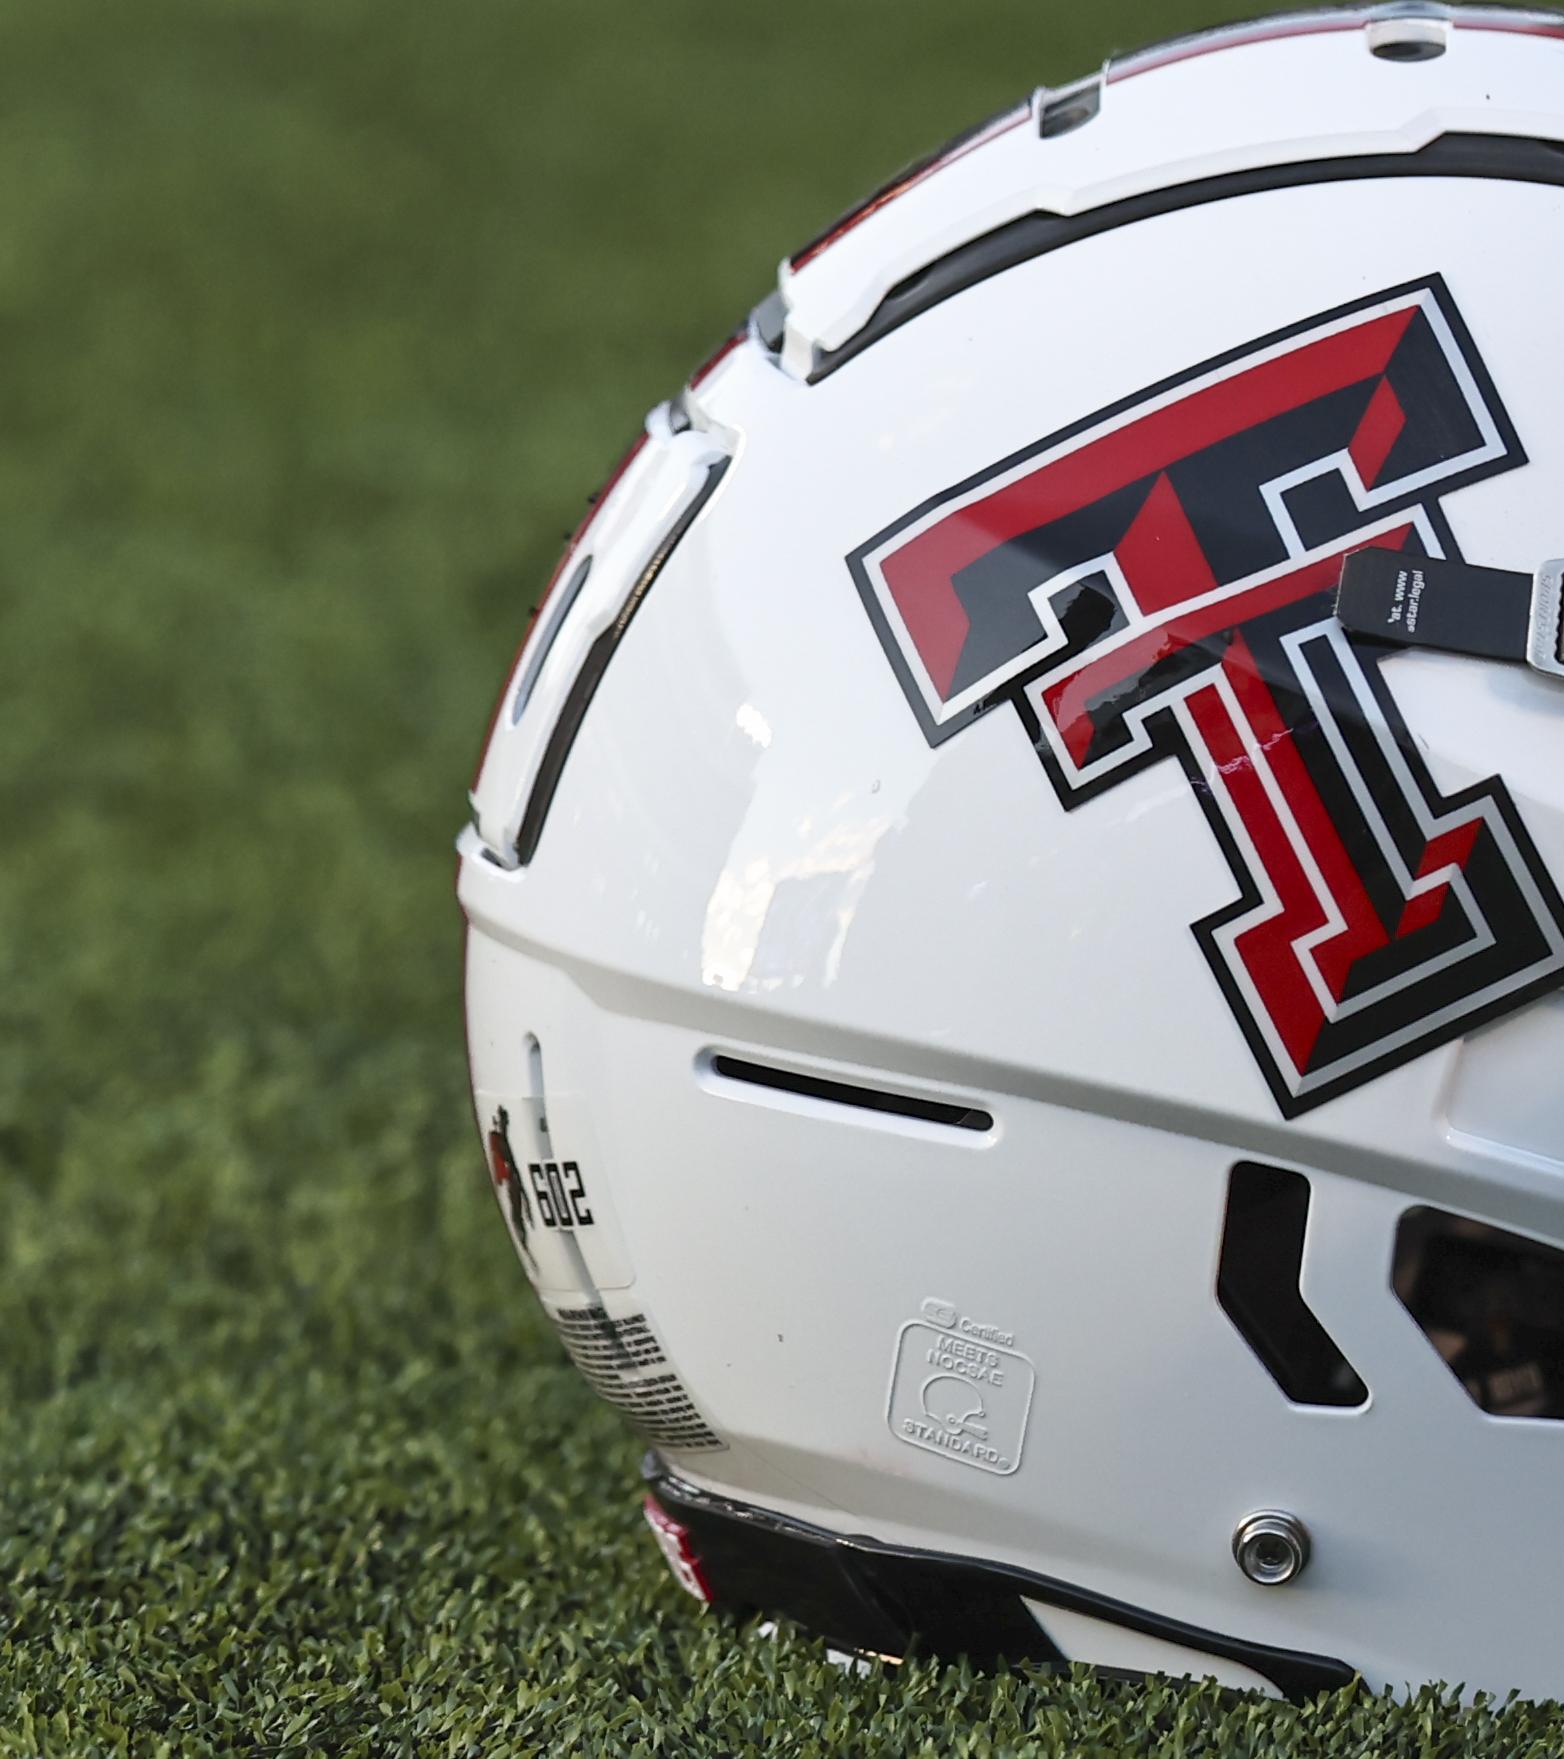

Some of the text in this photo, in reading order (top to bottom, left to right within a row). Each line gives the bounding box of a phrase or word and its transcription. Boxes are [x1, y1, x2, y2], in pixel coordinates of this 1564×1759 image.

[528, 1160, 594, 1228] 602
[926, 1348, 1005, 1388] NOCSAE
[937, 1334, 1001, 1368] MEETS
[902, 1417, 1000, 1465] STANDARD
